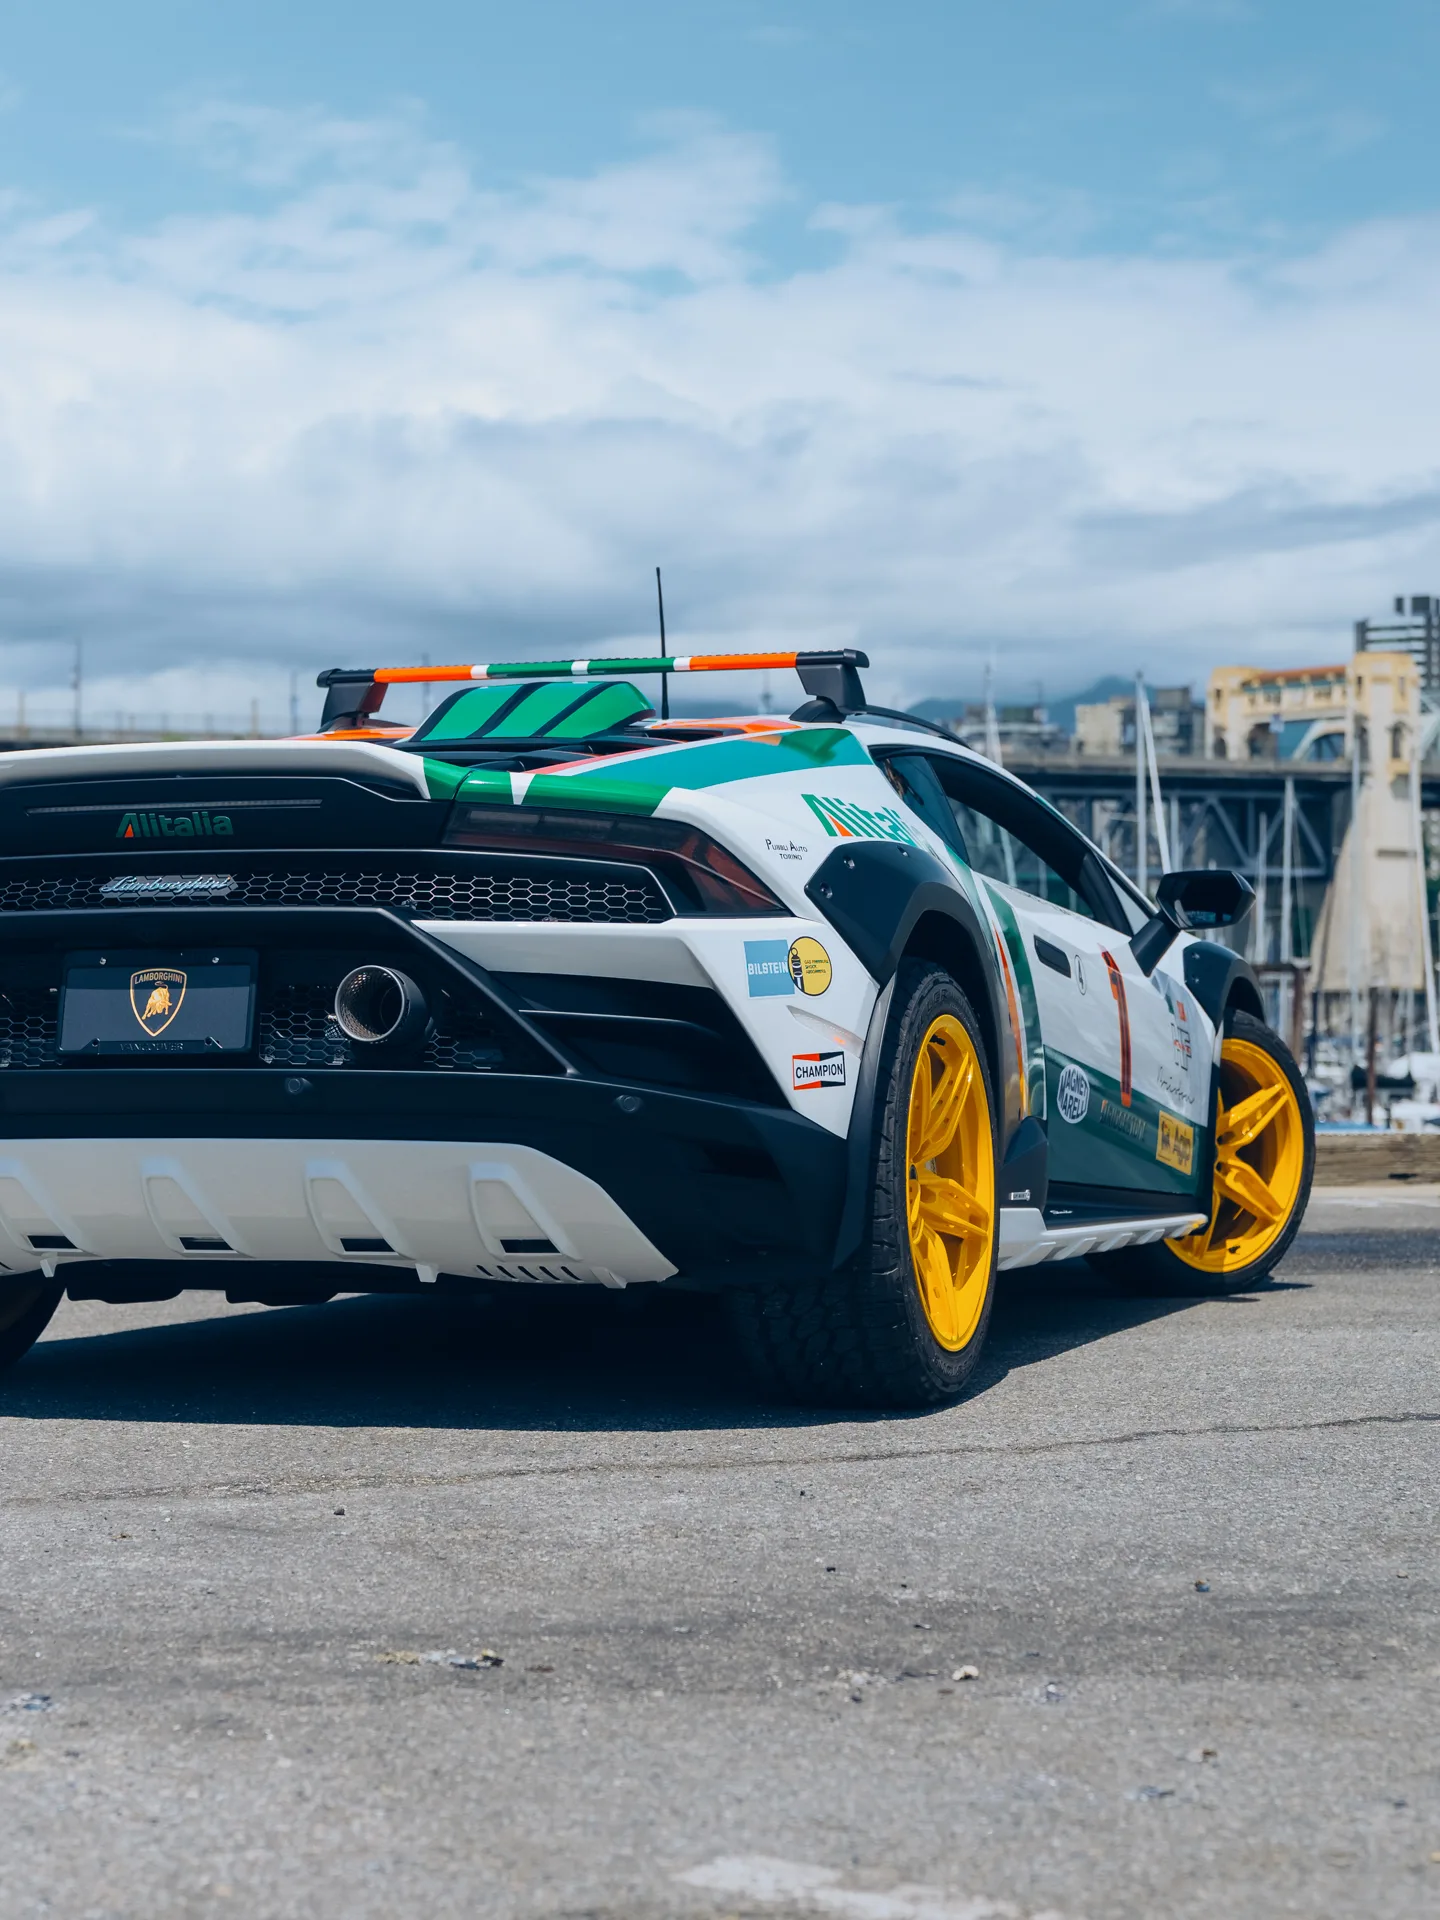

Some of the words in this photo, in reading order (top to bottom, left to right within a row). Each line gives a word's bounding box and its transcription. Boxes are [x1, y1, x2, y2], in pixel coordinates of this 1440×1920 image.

[115, 811, 234, 839] Alitalia
[101, 876, 232, 894] Lamborghini
[747, 961, 789, 976] BILSTEIN
[134, 972, 183, 985] LAMBORGHINI
[795, 1063, 843, 1079] CHAMPION
